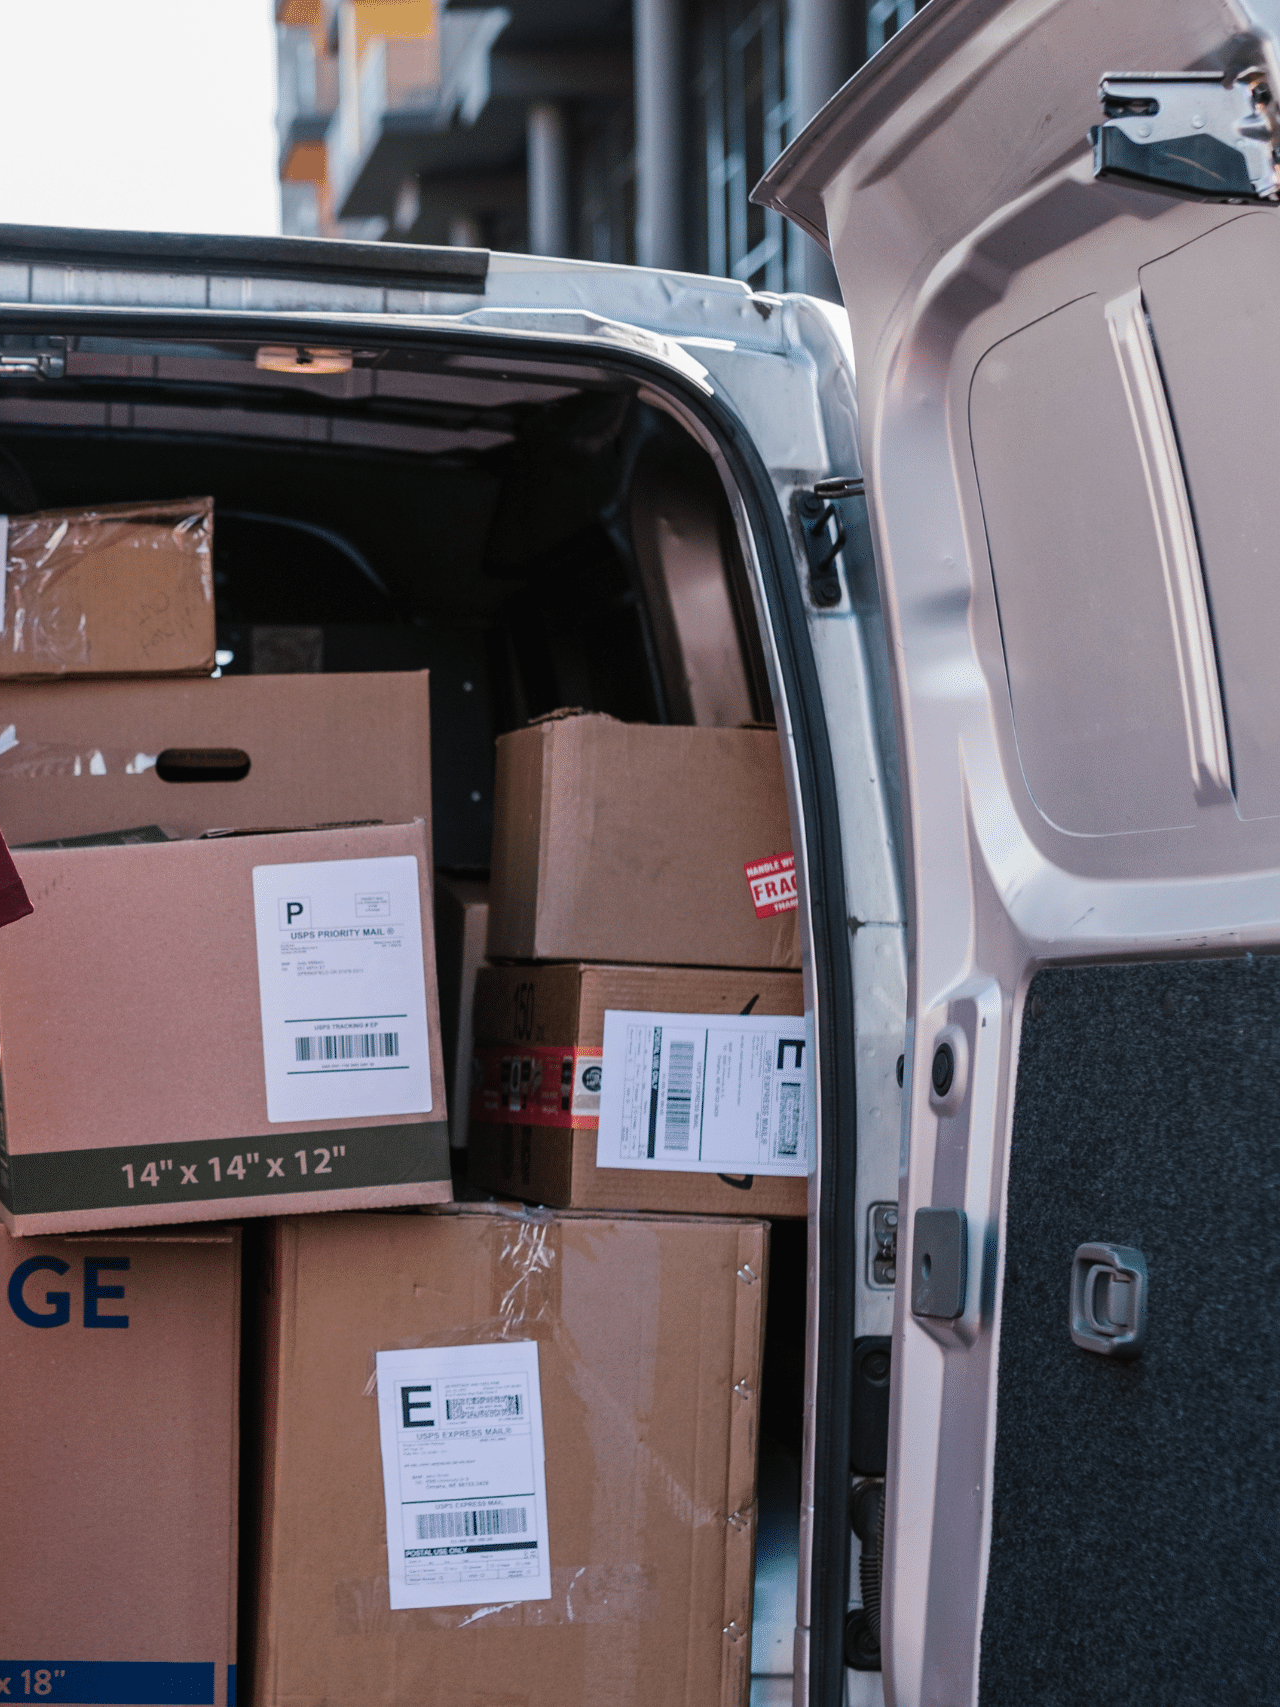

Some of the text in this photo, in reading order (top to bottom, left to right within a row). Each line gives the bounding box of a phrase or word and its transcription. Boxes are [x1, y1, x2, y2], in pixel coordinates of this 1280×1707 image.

[746, 860, 780, 878] HANDLE
[287, 902, 304, 924] P
[290, 930, 316, 940] USPS
[318, 928, 361, 938] PRIORITY
[362, 928, 385, 937] MAIL
[332, 1022, 364, 1030] TRACKING
[121, 1145, 346, 1189] 14" x 14" x 12"
[400, 1385, 435, 1428] E
[416, 1432, 440, 1441] USPS
[442, 1429, 483, 1439] EXPRESS
[455, 1500, 487, 1508] EXPRESS
[405, 1546, 469, 1558] POSTAL USE ONLY
[20, 1668, 66, 1696] 18"
